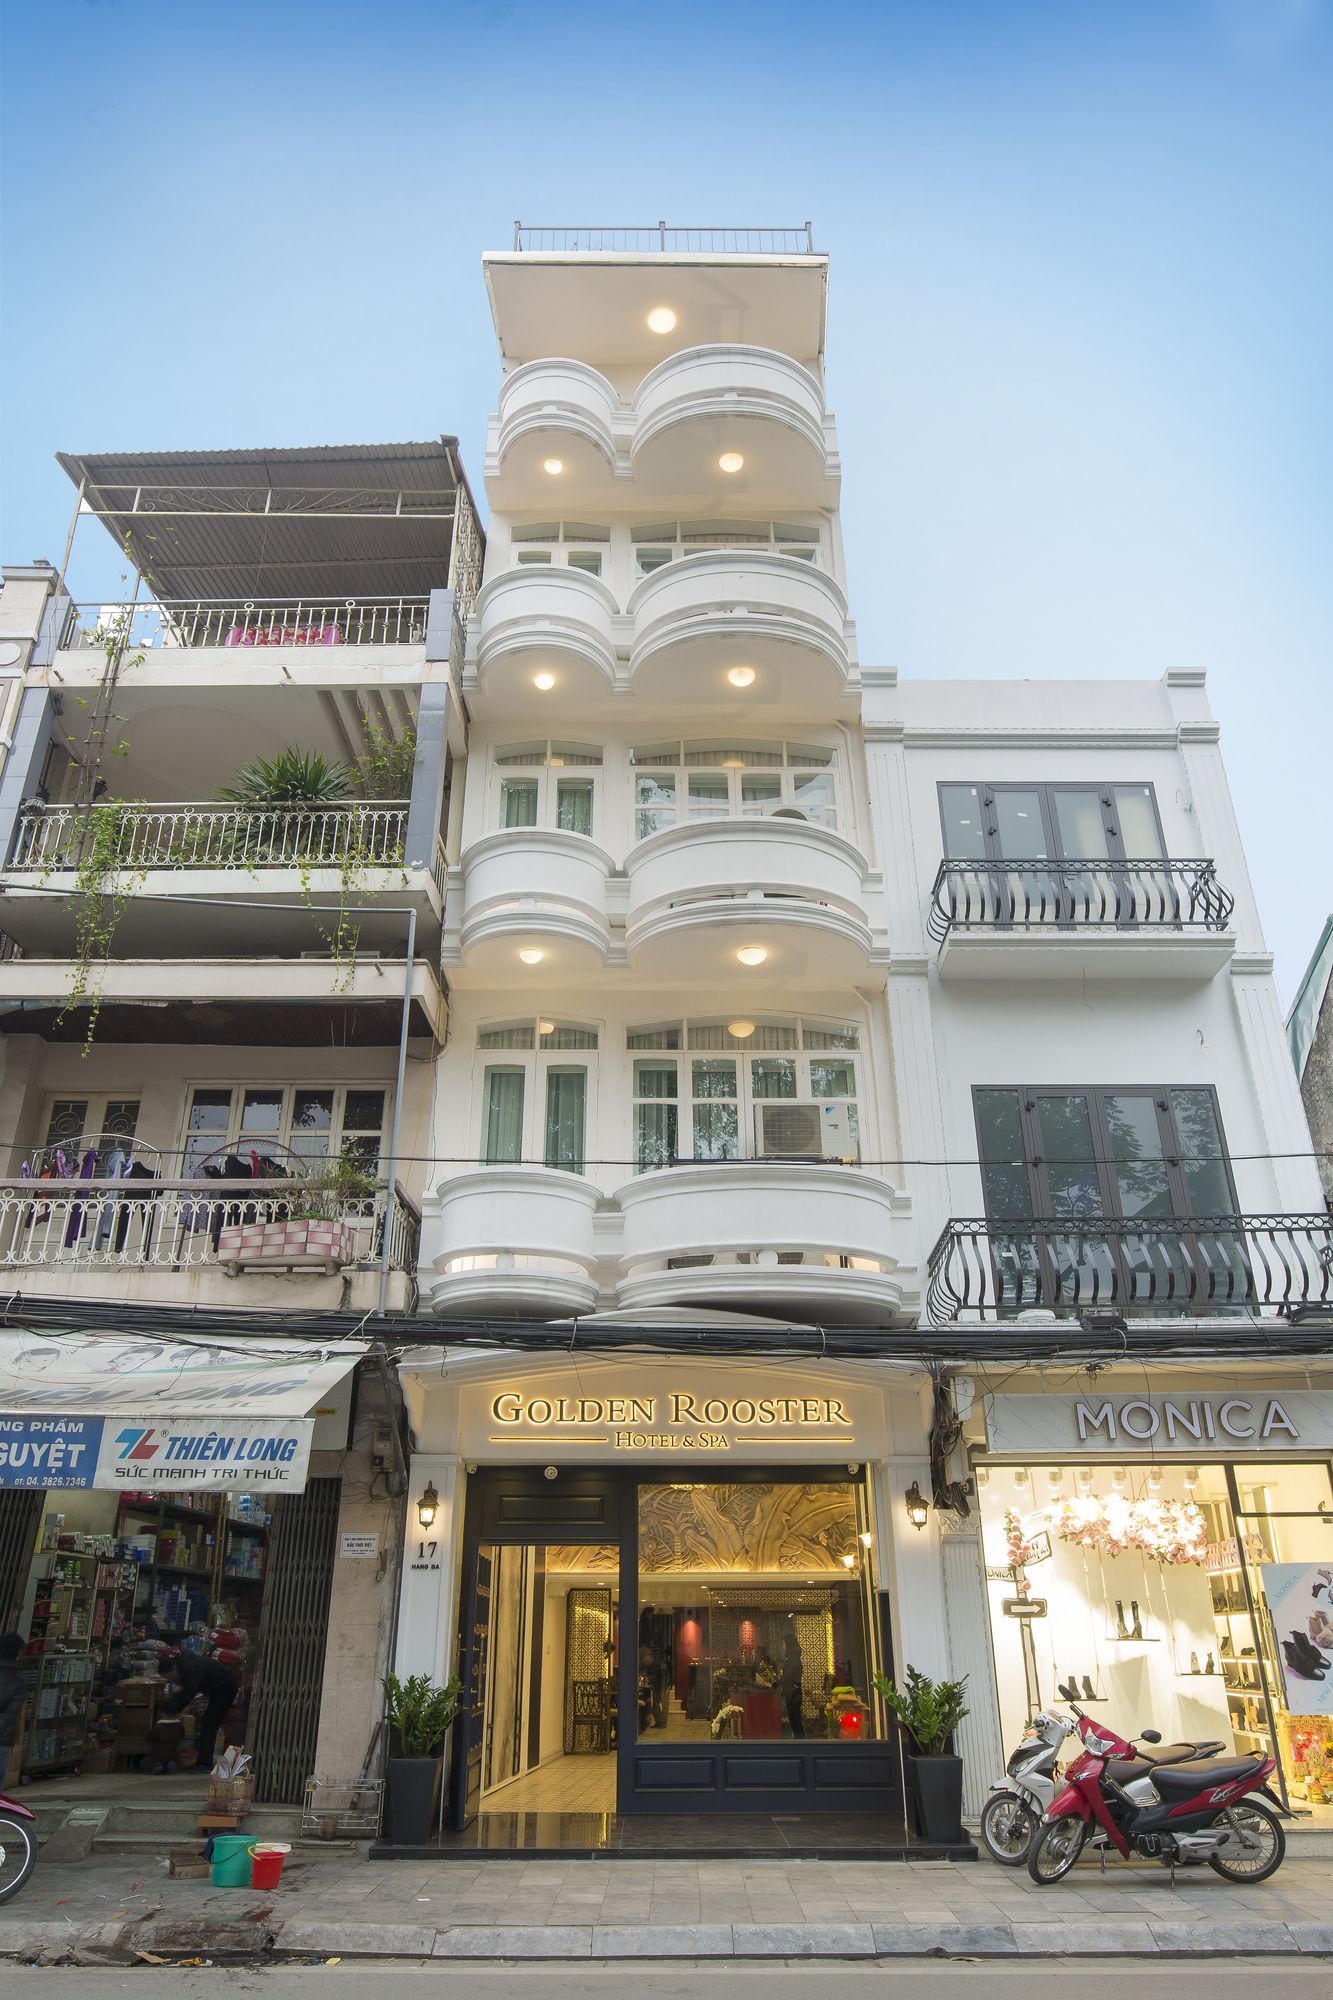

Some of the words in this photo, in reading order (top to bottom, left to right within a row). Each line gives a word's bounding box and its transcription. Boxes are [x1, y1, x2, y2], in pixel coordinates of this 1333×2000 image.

[492, 1393, 655, 1424] GOLDEN
[670, 1393, 852, 1424] ROOSTER
[0, 1421, 24, 1432] NG
[30, 1418, 84, 1433] PHẨM
[1075, 1400, 1300, 1440] MONICA
[164, 1432, 235, 1461] THIÊN
[233, 1438, 299, 1462] LONG
[42, 1476, 86, 1487] 3826.7346
[152, 1468, 206, 1479] MẠNH
[212, 1468, 237, 1478] TRI
[418, 1541, 438, 1558] 17
